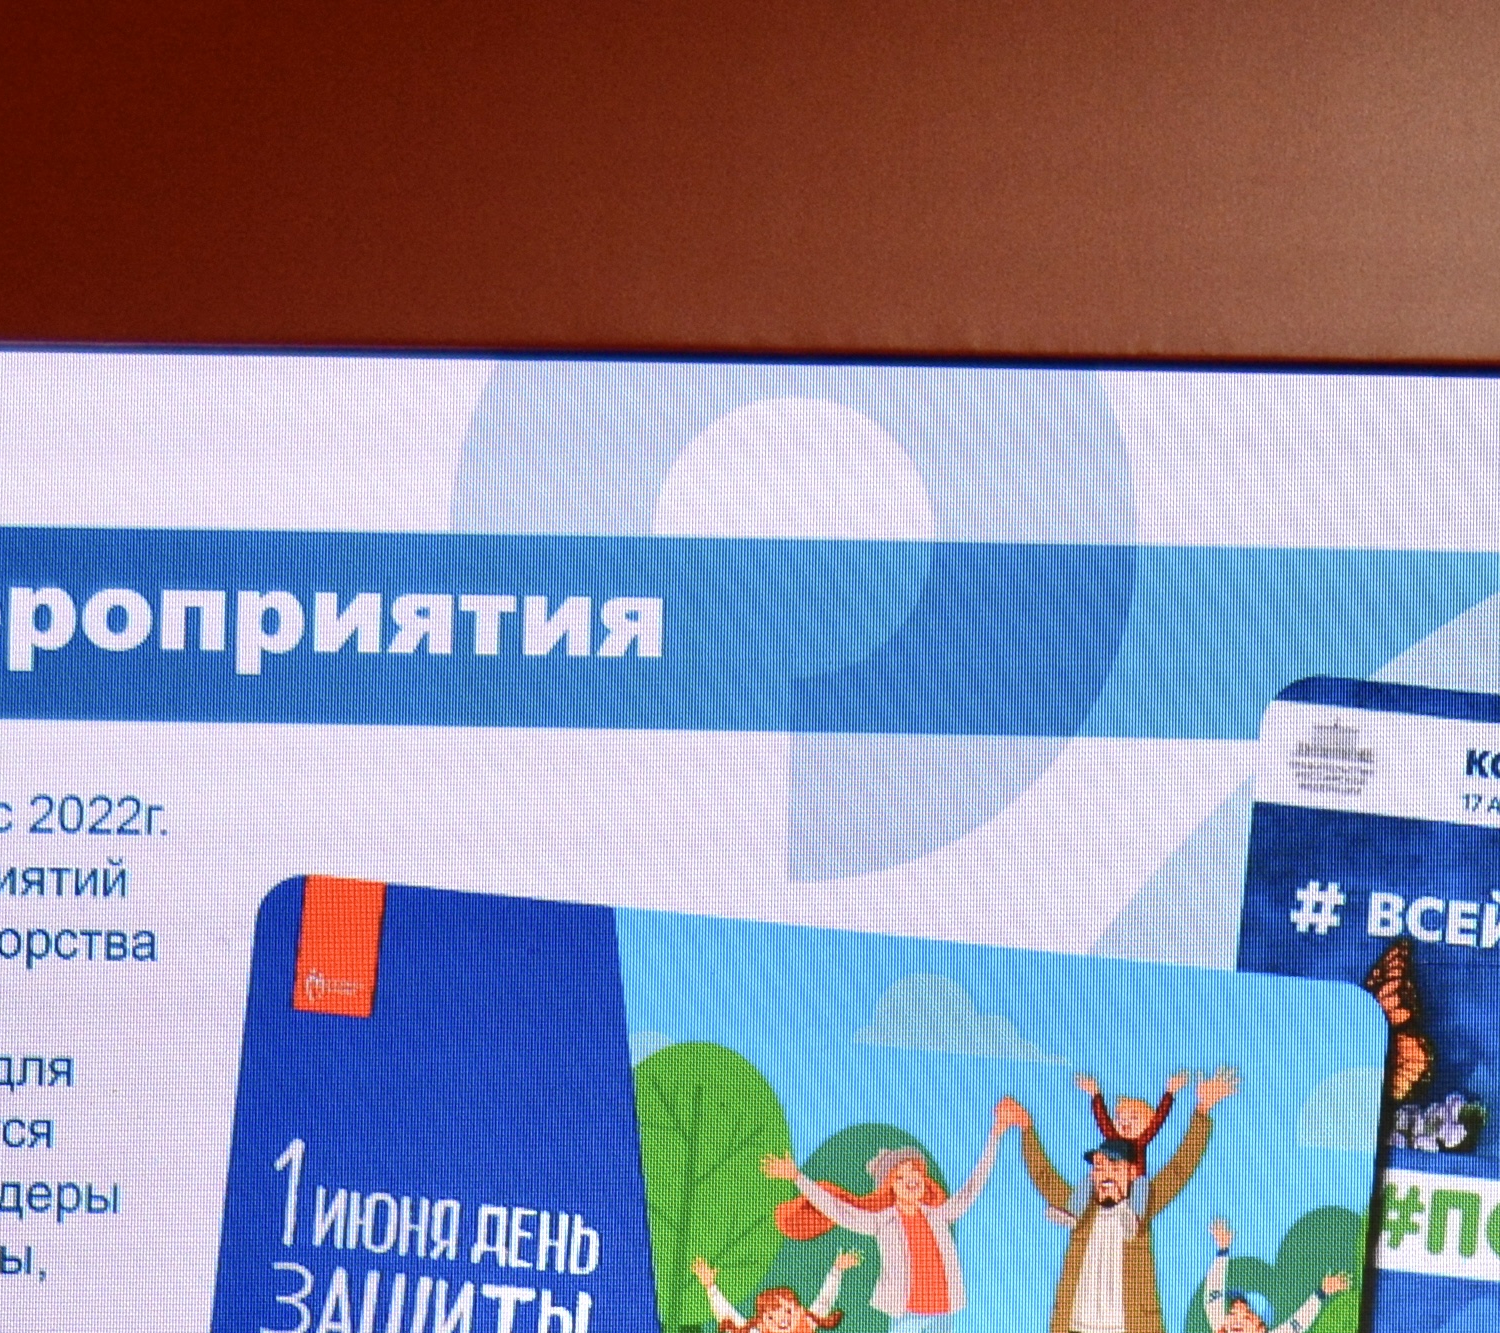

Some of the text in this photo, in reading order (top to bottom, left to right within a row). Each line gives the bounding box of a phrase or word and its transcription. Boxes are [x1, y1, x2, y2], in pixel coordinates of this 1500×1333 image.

[27, 793, 169, 837] 2022г.
[273, 1137, 600, 1275] 1 ИЮНЯ ДЕНЬ
